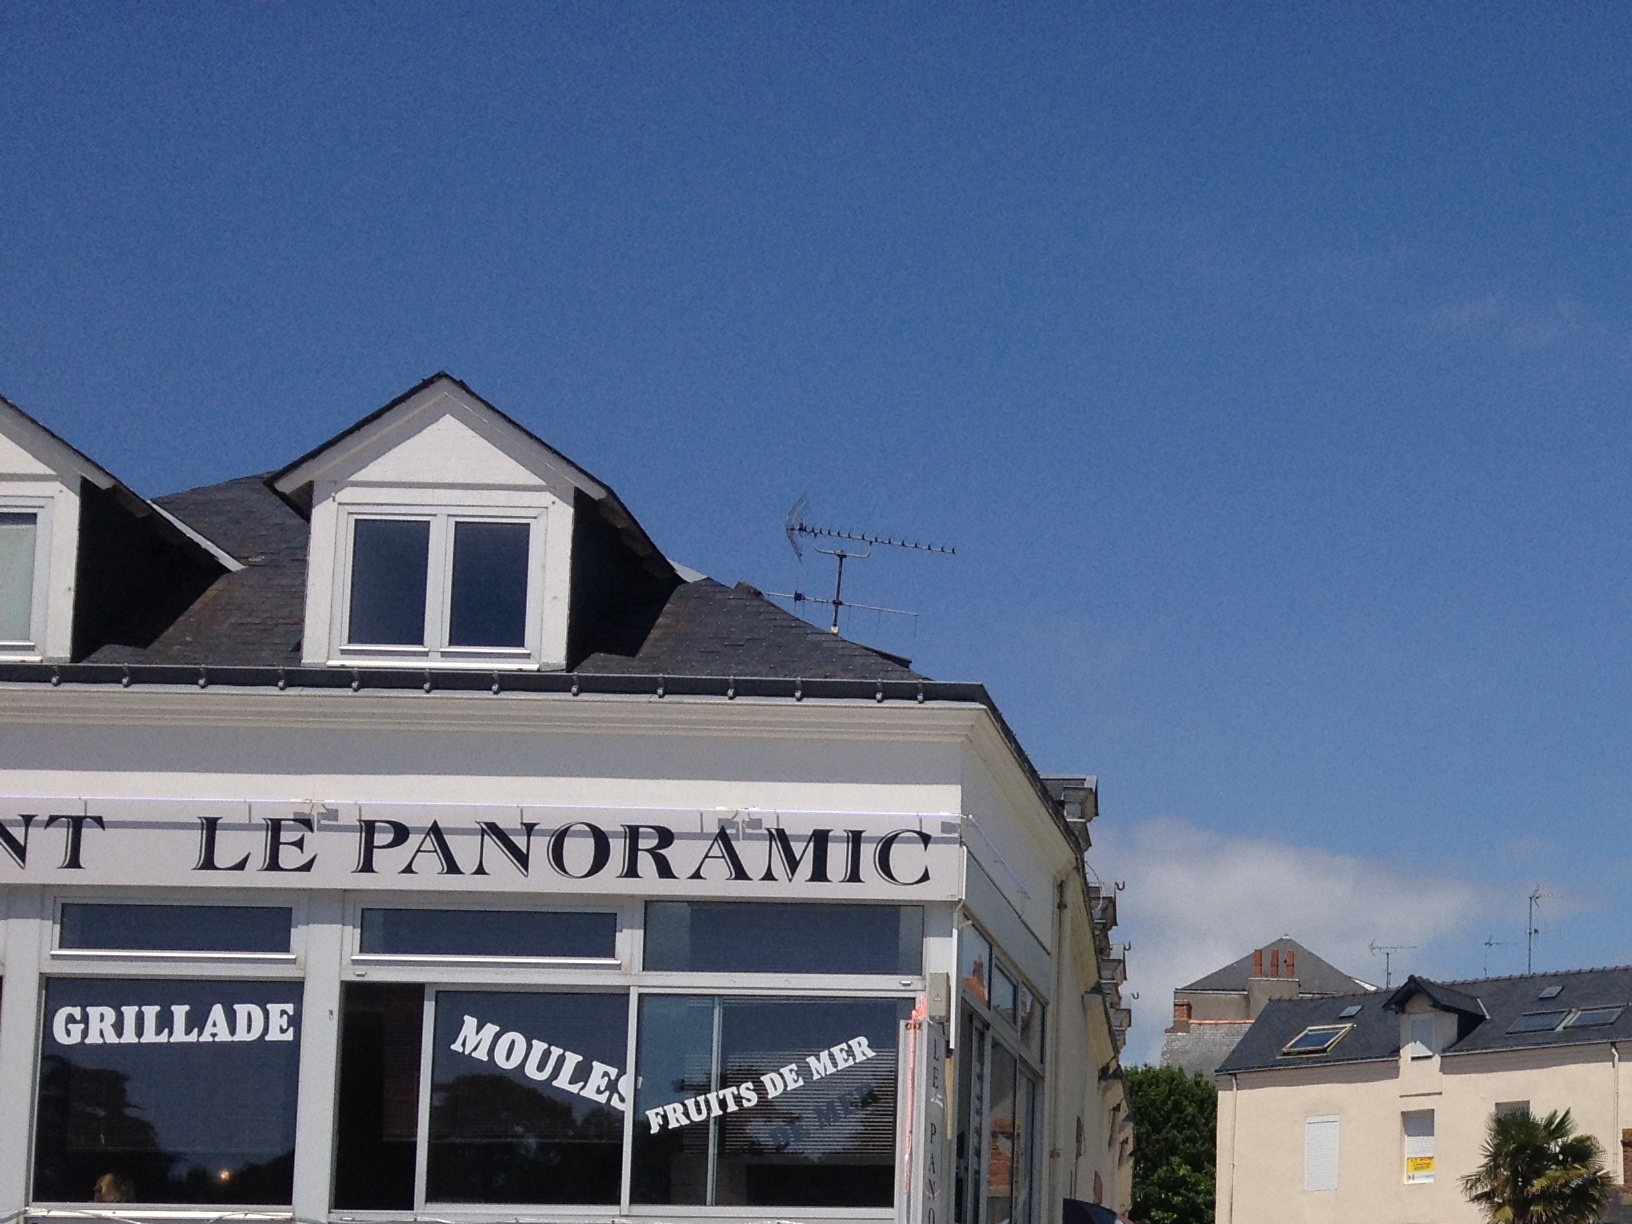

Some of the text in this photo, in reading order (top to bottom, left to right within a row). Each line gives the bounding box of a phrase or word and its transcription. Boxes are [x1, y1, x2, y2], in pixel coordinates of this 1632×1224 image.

[191, 816, 318, 872] LE
[350, 818, 932, 887] PANORAMIC
[53, 1003, 294, 1045] GRILLADE
[450, 1015, 643, 1112] MOULES
[646, 1035, 877, 1134] FRUITS DE MER
